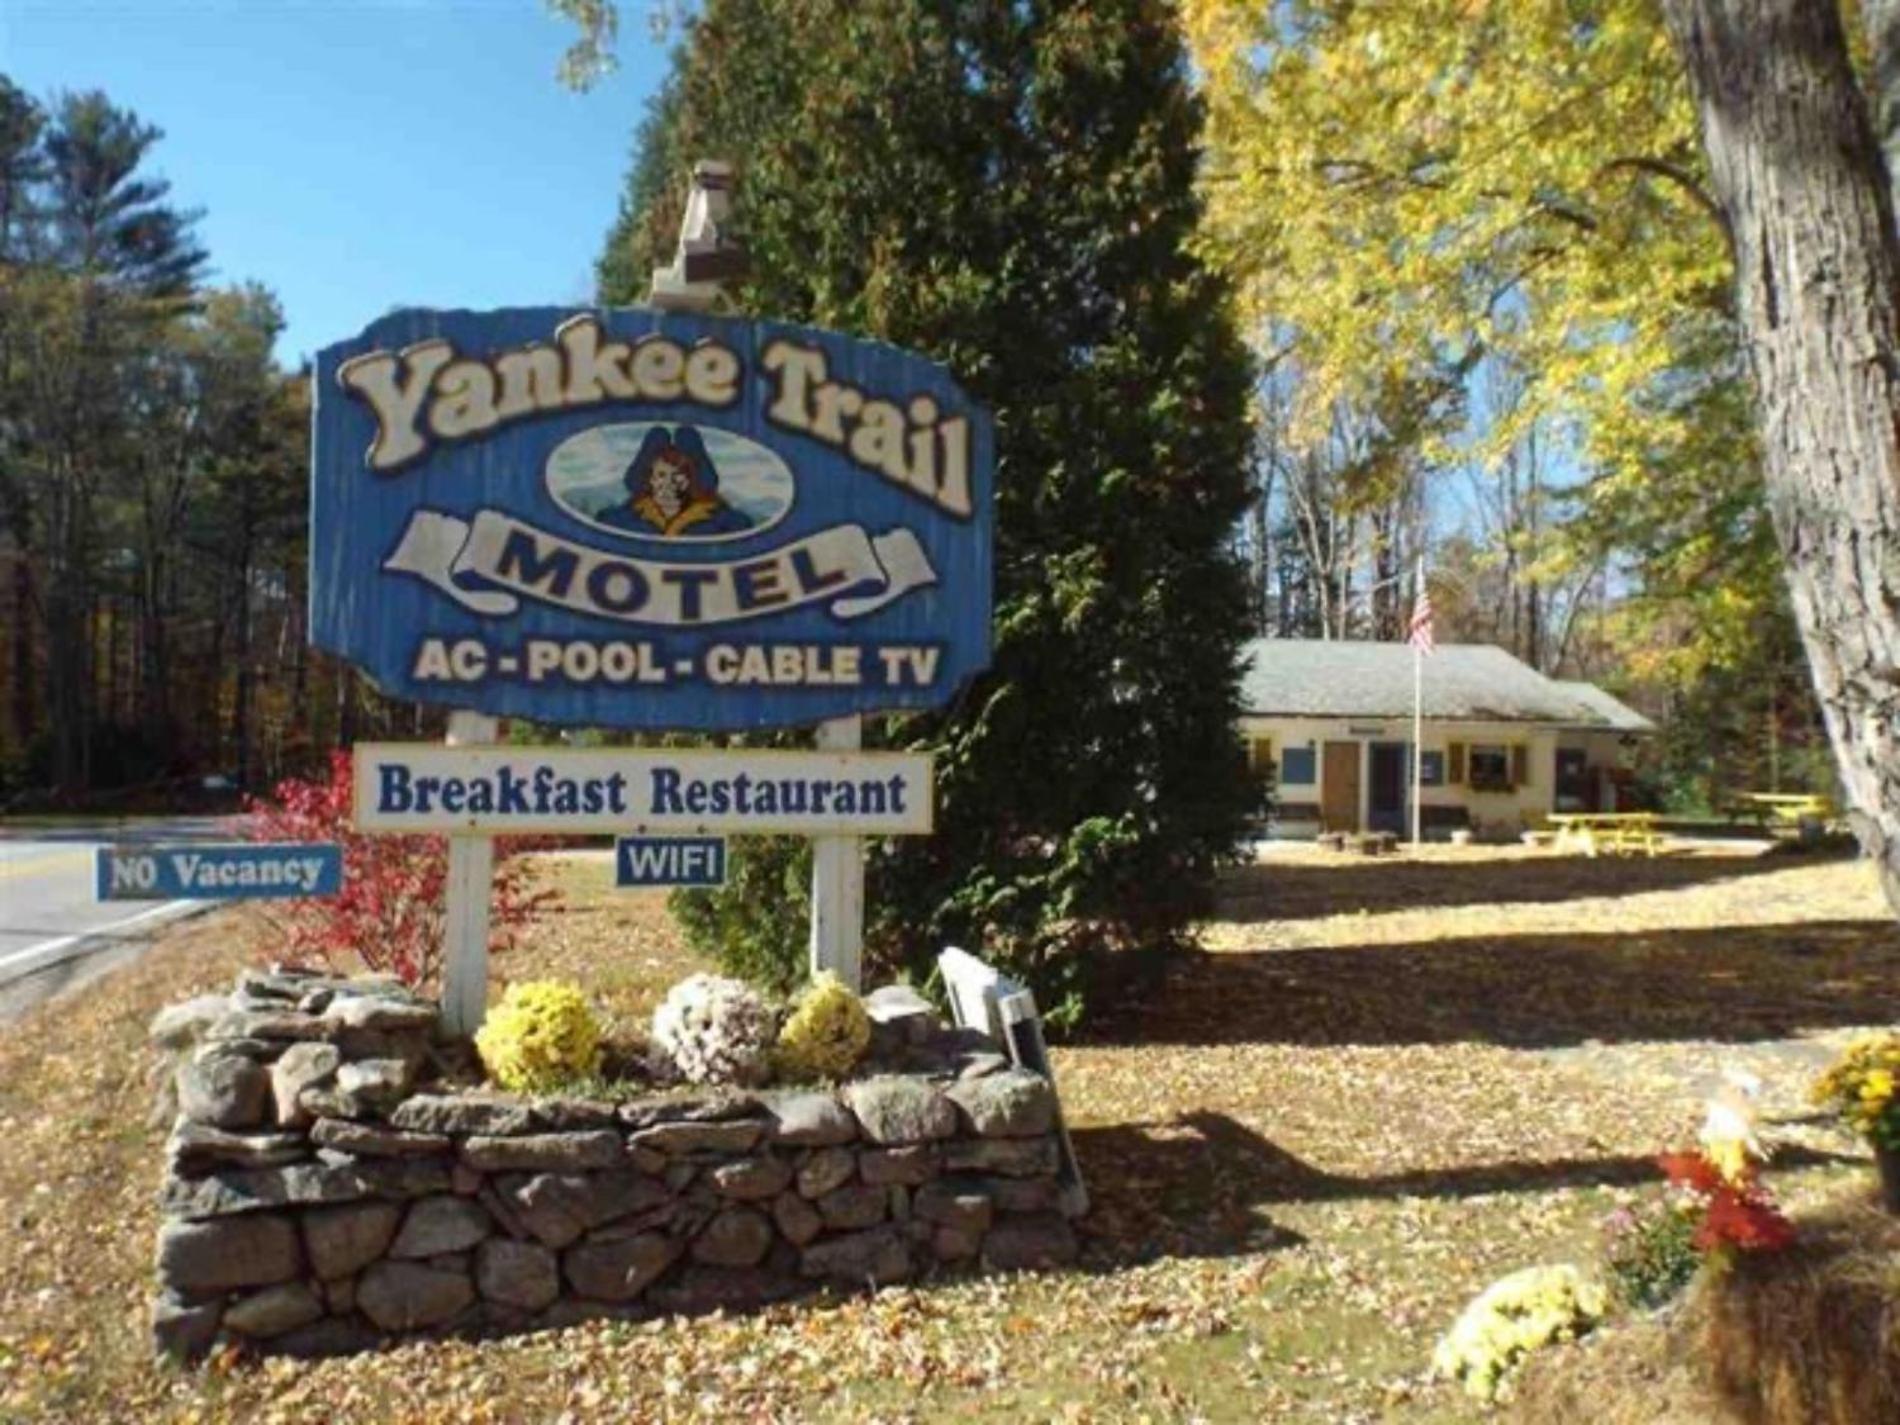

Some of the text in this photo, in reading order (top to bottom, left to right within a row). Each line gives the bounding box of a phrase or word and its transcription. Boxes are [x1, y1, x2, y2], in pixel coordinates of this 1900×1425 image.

[339, 315, 972, 517] Yankee Trail
[498, 529, 848, 620] MOTEL
[414, 640, 487, 681] AC
[528, 643, 666, 684] POOL
[706, 645, 860, 685] CABLE
[879, 648, 939, 684] TV
[376, 764, 907, 816] Breakfast Restaurant
[112, 854, 325, 891] NO Vacancy
[627, 846, 718, 881] WIFI
